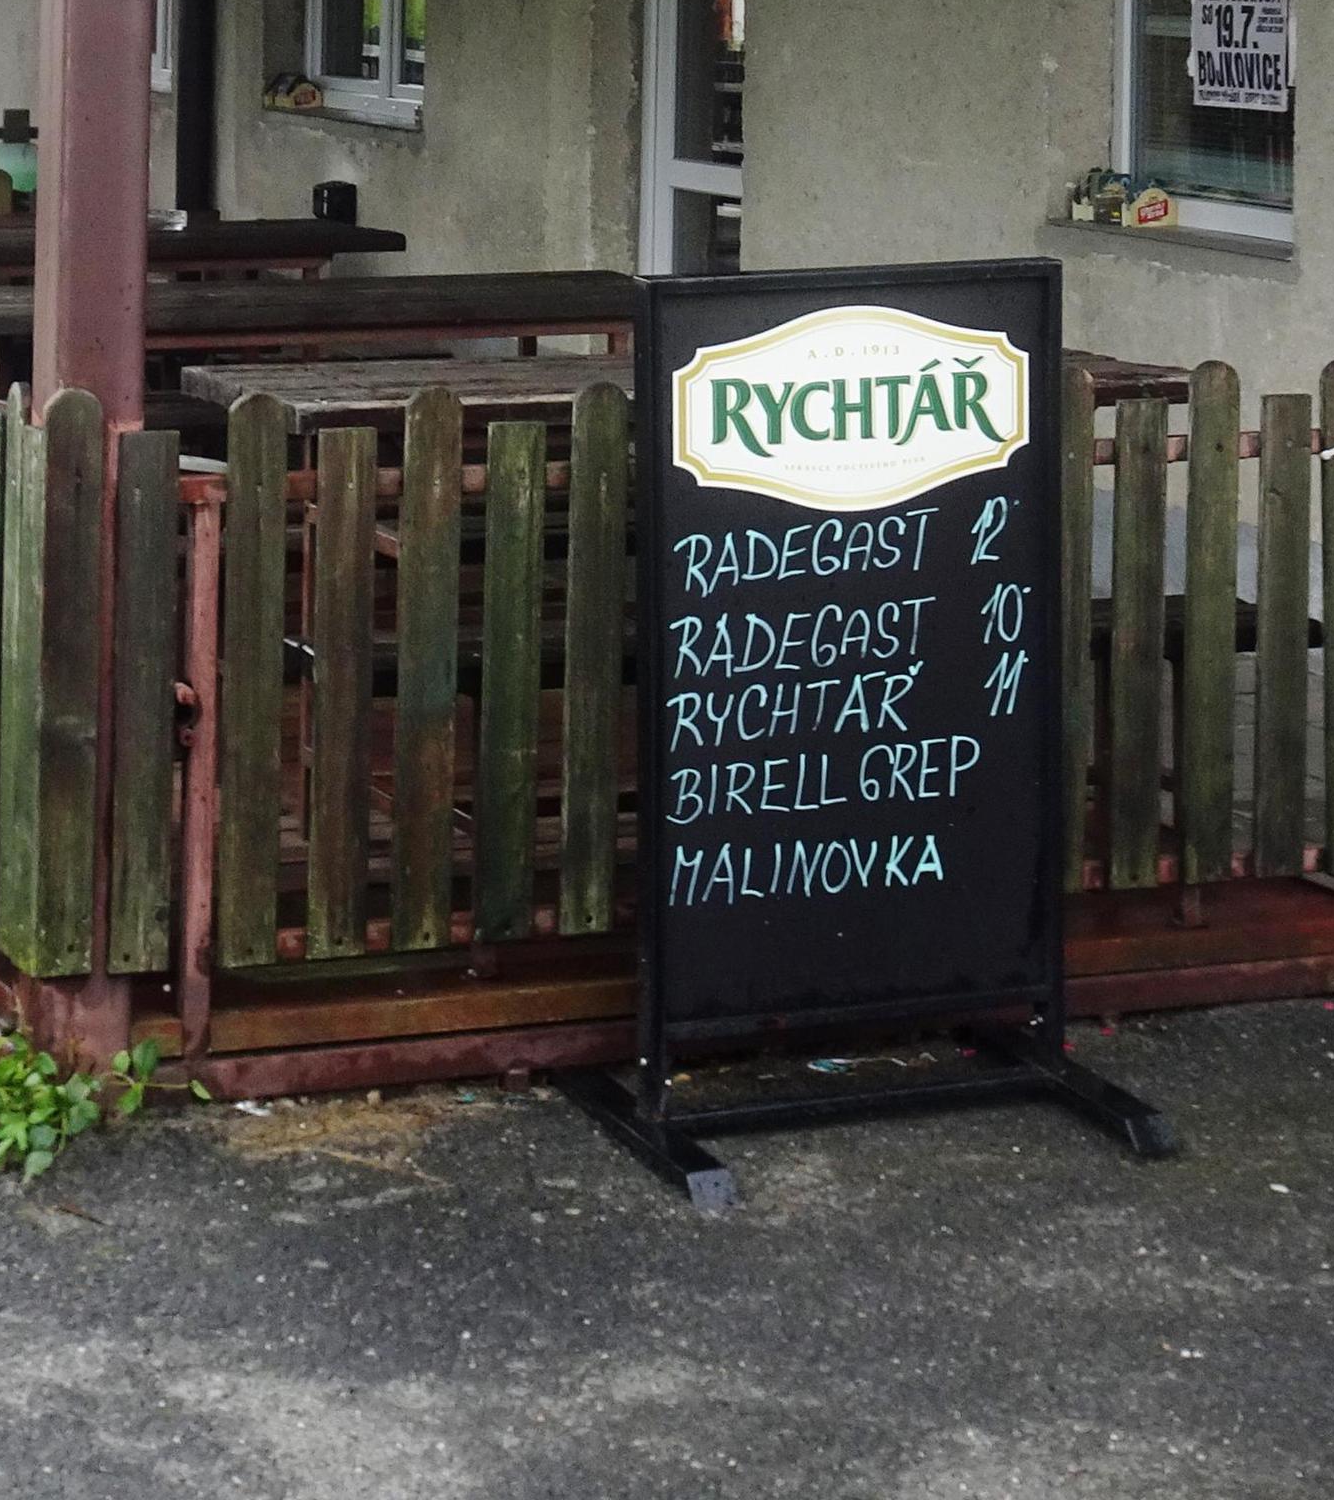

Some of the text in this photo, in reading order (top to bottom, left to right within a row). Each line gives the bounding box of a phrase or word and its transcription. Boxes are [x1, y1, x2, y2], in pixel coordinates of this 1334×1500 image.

[1197, 50, 1282, 91] BOJKOVICE
[710, 356, 1008, 458] RYCHTÁŘ
[673, 507, 939, 597] RADEGAST
[669, 597, 936, 678] RADEGAST
[666, 735, 980, 825] BIRELL GREP
[668, 834, 944, 906] MALINOVKA
